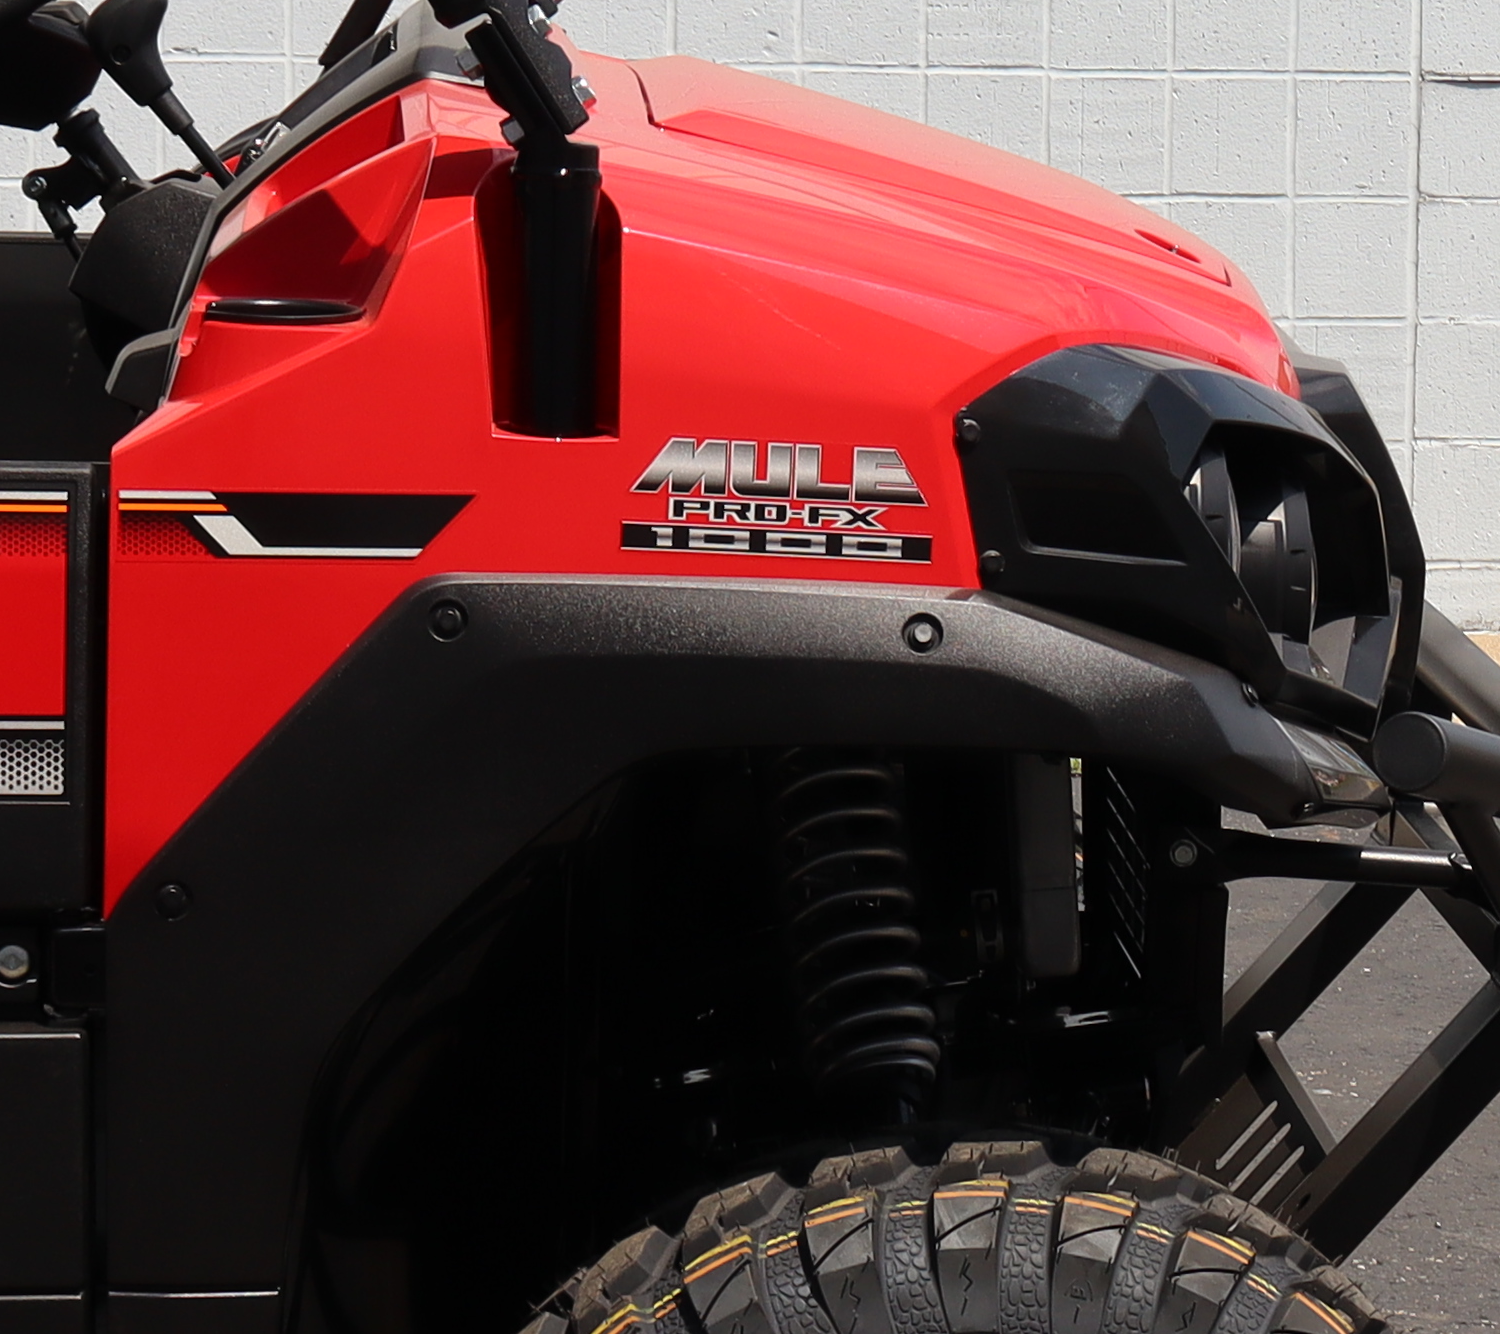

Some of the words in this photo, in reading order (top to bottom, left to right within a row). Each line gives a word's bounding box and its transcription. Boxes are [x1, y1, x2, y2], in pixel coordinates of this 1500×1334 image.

[629, 437, 929, 507] MULE
[668, 496, 889, 530] PRO-FX
[651, 526, 903, 558] 1000
